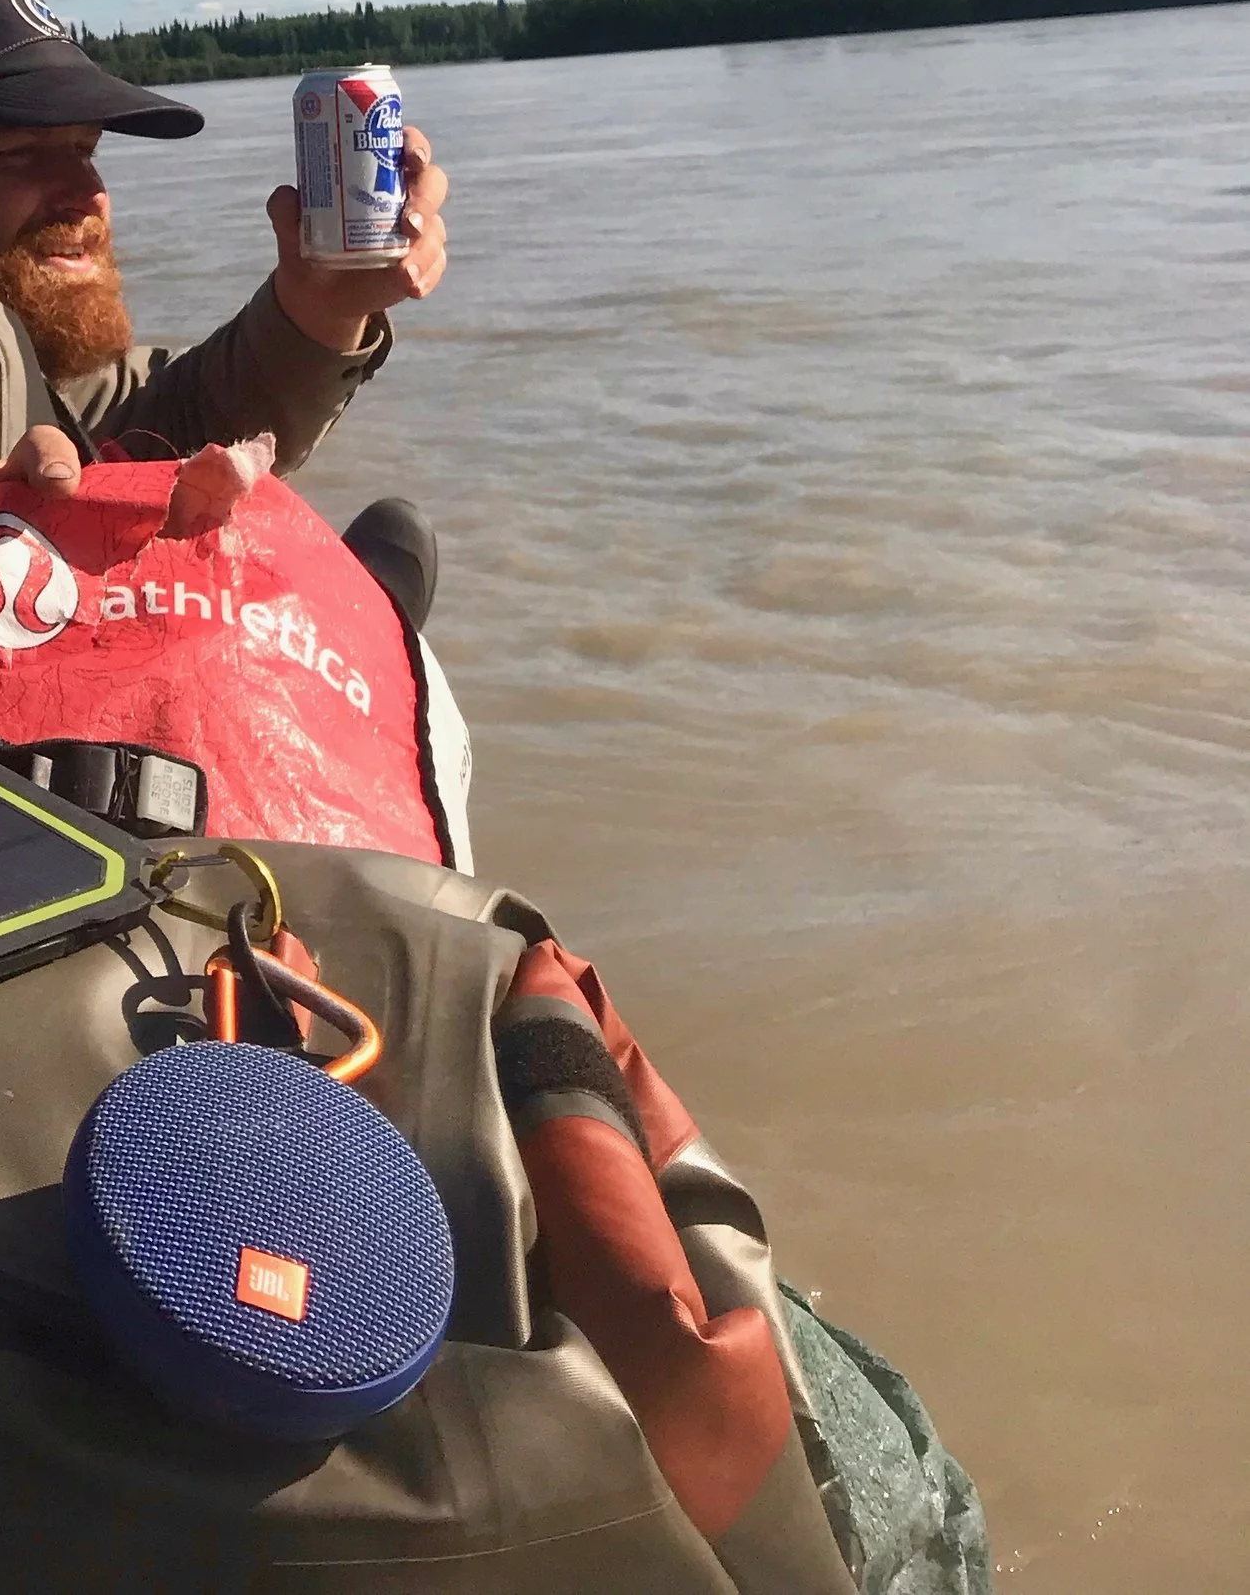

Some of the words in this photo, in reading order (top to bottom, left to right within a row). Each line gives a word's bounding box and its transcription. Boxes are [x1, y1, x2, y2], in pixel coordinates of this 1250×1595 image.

[357, 131, 388, 149] Blue
[101, 581, 371, 717] athletica
[151, 774, 162, 800] USE
[160, 765, 173, 816] BEFORE
[172, 780, 182, 806] OFF
[181, 778, 193, 815] SLIDE
[249, 1264, 290, 1301] JBL
